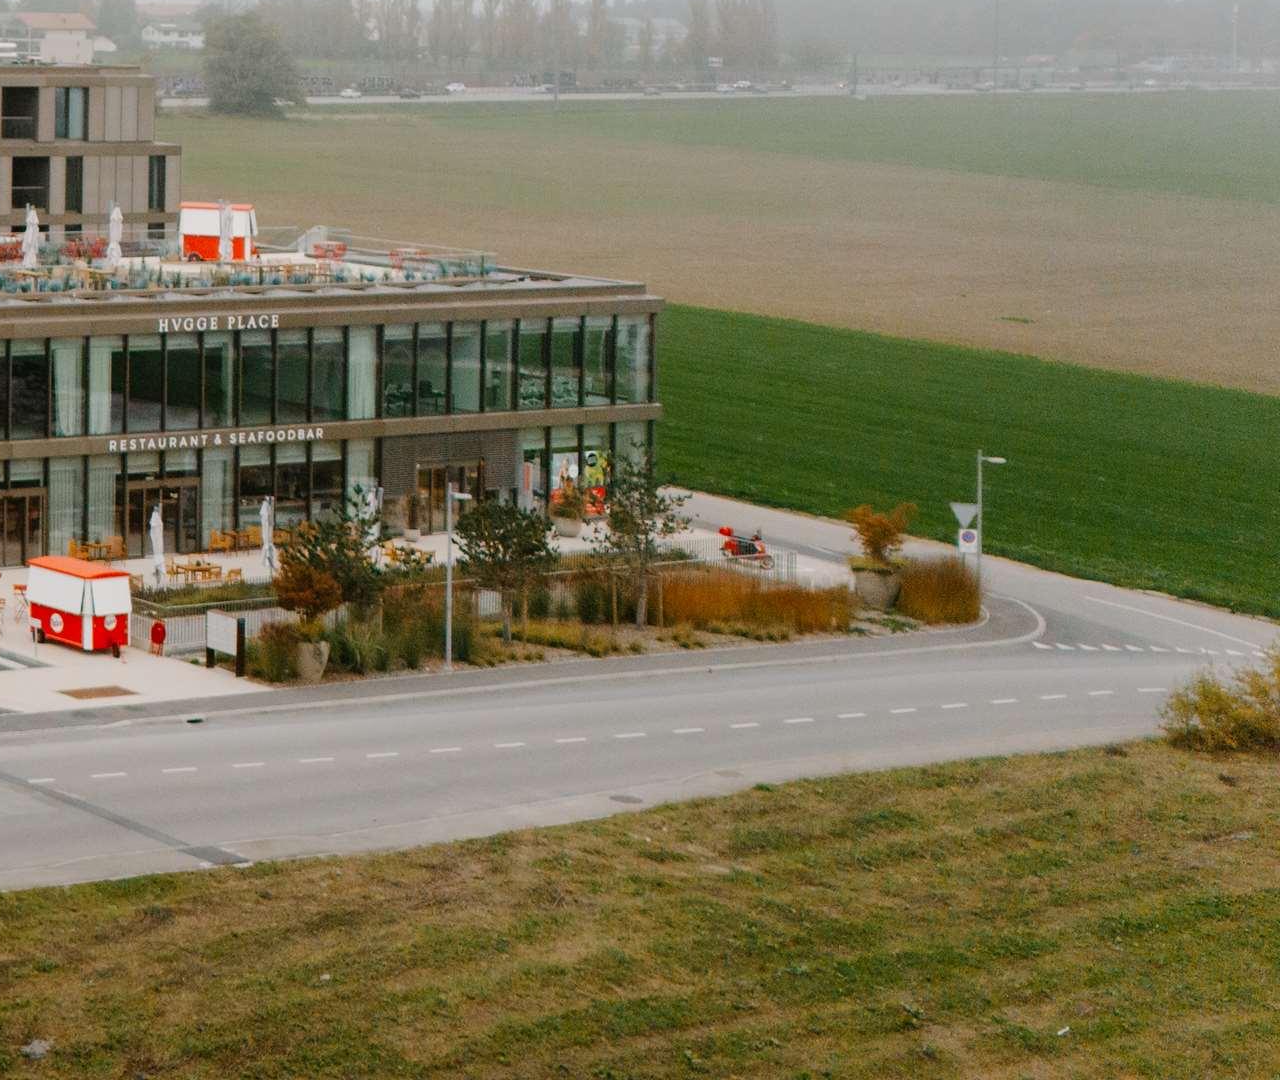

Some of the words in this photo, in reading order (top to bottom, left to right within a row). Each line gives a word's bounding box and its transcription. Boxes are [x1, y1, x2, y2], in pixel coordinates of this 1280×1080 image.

[227, 314, 280, 330] PLACE
[109, 434, 208, 453] RESTAURANT
[214, 433, 222, 445] &
[229, 427, 325, 445] SEAFOODBAR
